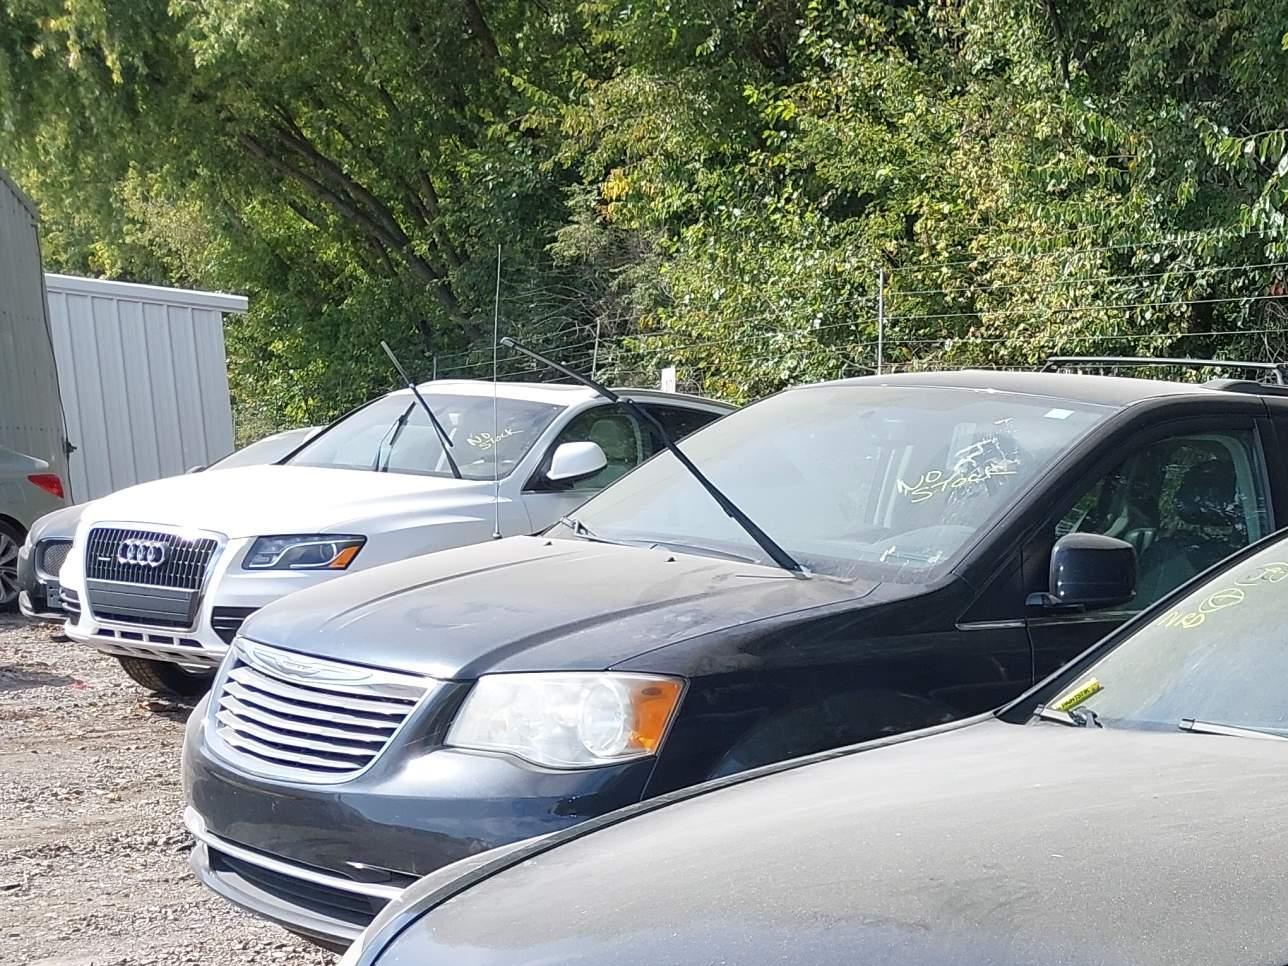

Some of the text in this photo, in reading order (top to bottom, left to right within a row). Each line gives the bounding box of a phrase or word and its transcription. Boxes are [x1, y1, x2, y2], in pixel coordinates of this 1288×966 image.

[467, 432, 490, 446] NO
[896, 470, 942, 496] NO
[911, 462, 1017, 503] STOCK
